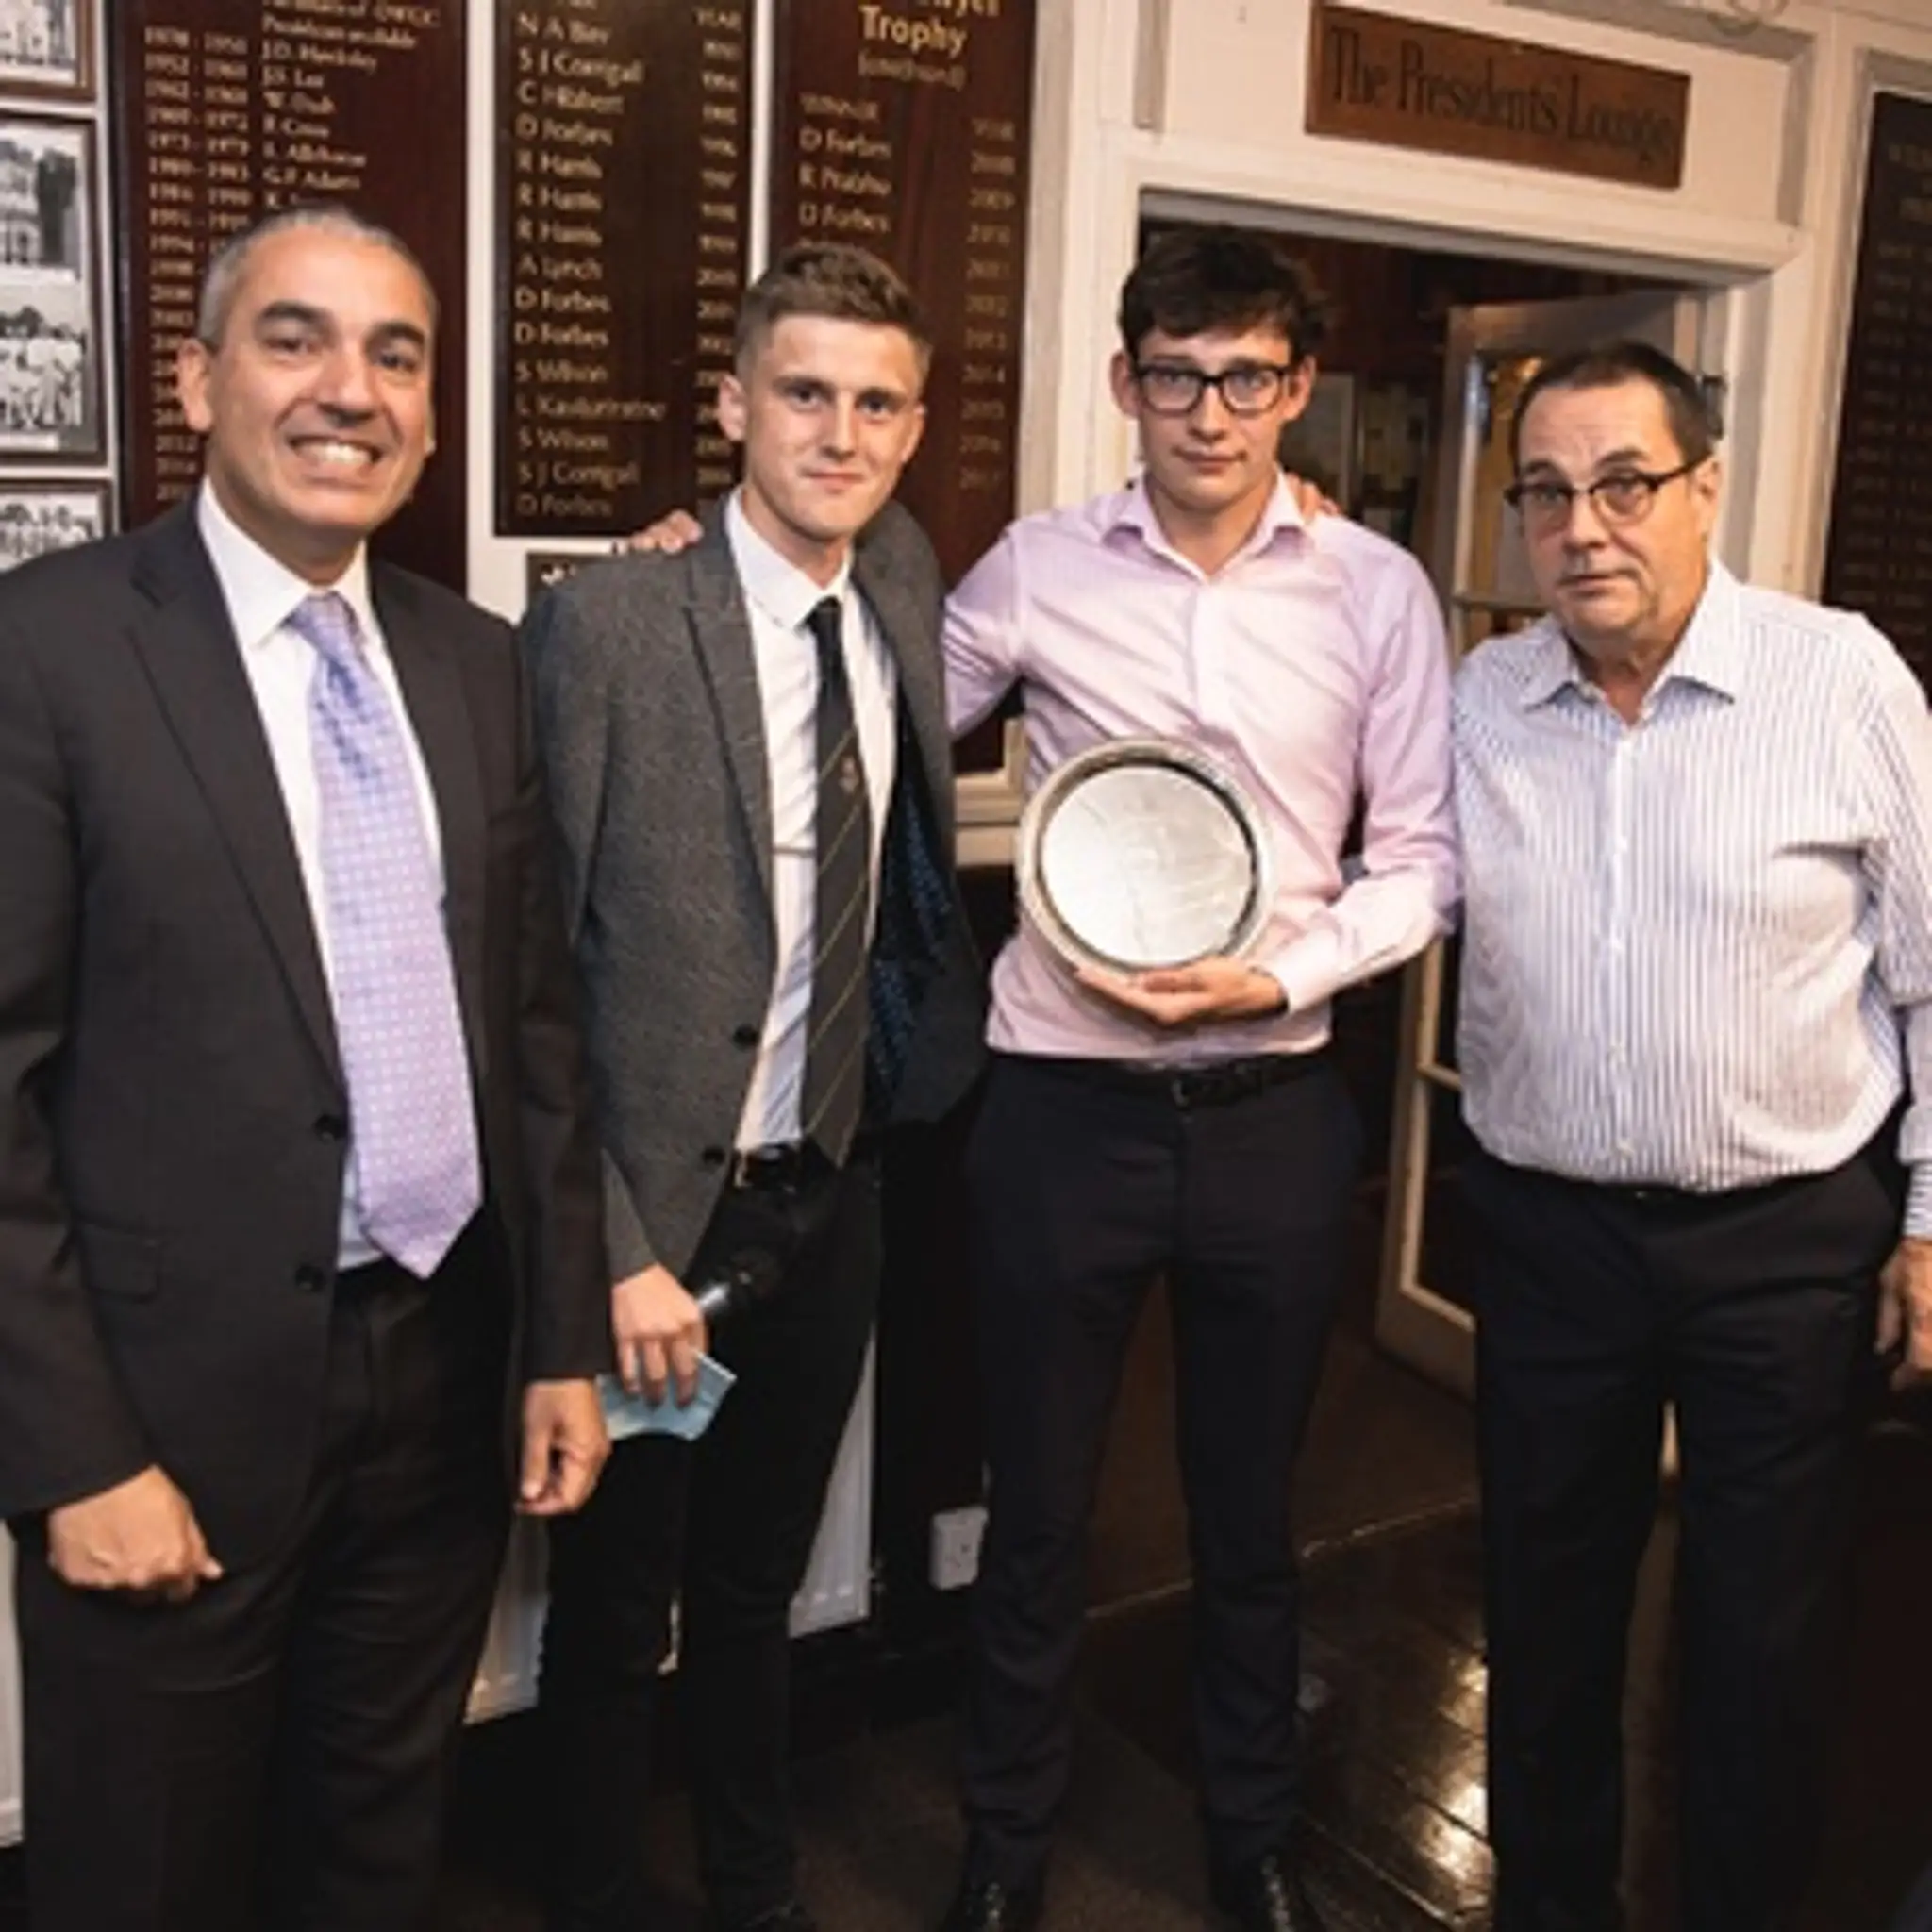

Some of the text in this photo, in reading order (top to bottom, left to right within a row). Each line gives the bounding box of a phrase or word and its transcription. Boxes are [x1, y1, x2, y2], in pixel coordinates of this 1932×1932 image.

[516, 12, 538, 38] N
[542, 15, 564, 41] A
[858, 5, 967, 58] Trophy
[518, 47, 534, 73] S
[1330, 26, 1387, 106] The
[518, 78, 537, 104] C
[799, 126, 823, 152] D
[518, 253, 538, 275] A
[514, 285, 612, 314] D Forbes
[514, 321, 610, 349] D Forbes
[515, 360, 532, 383] S
[519, 426, 533, 451] S
[518, 461, 533, 485] S
[541, 495, 612, 518] Forbes
